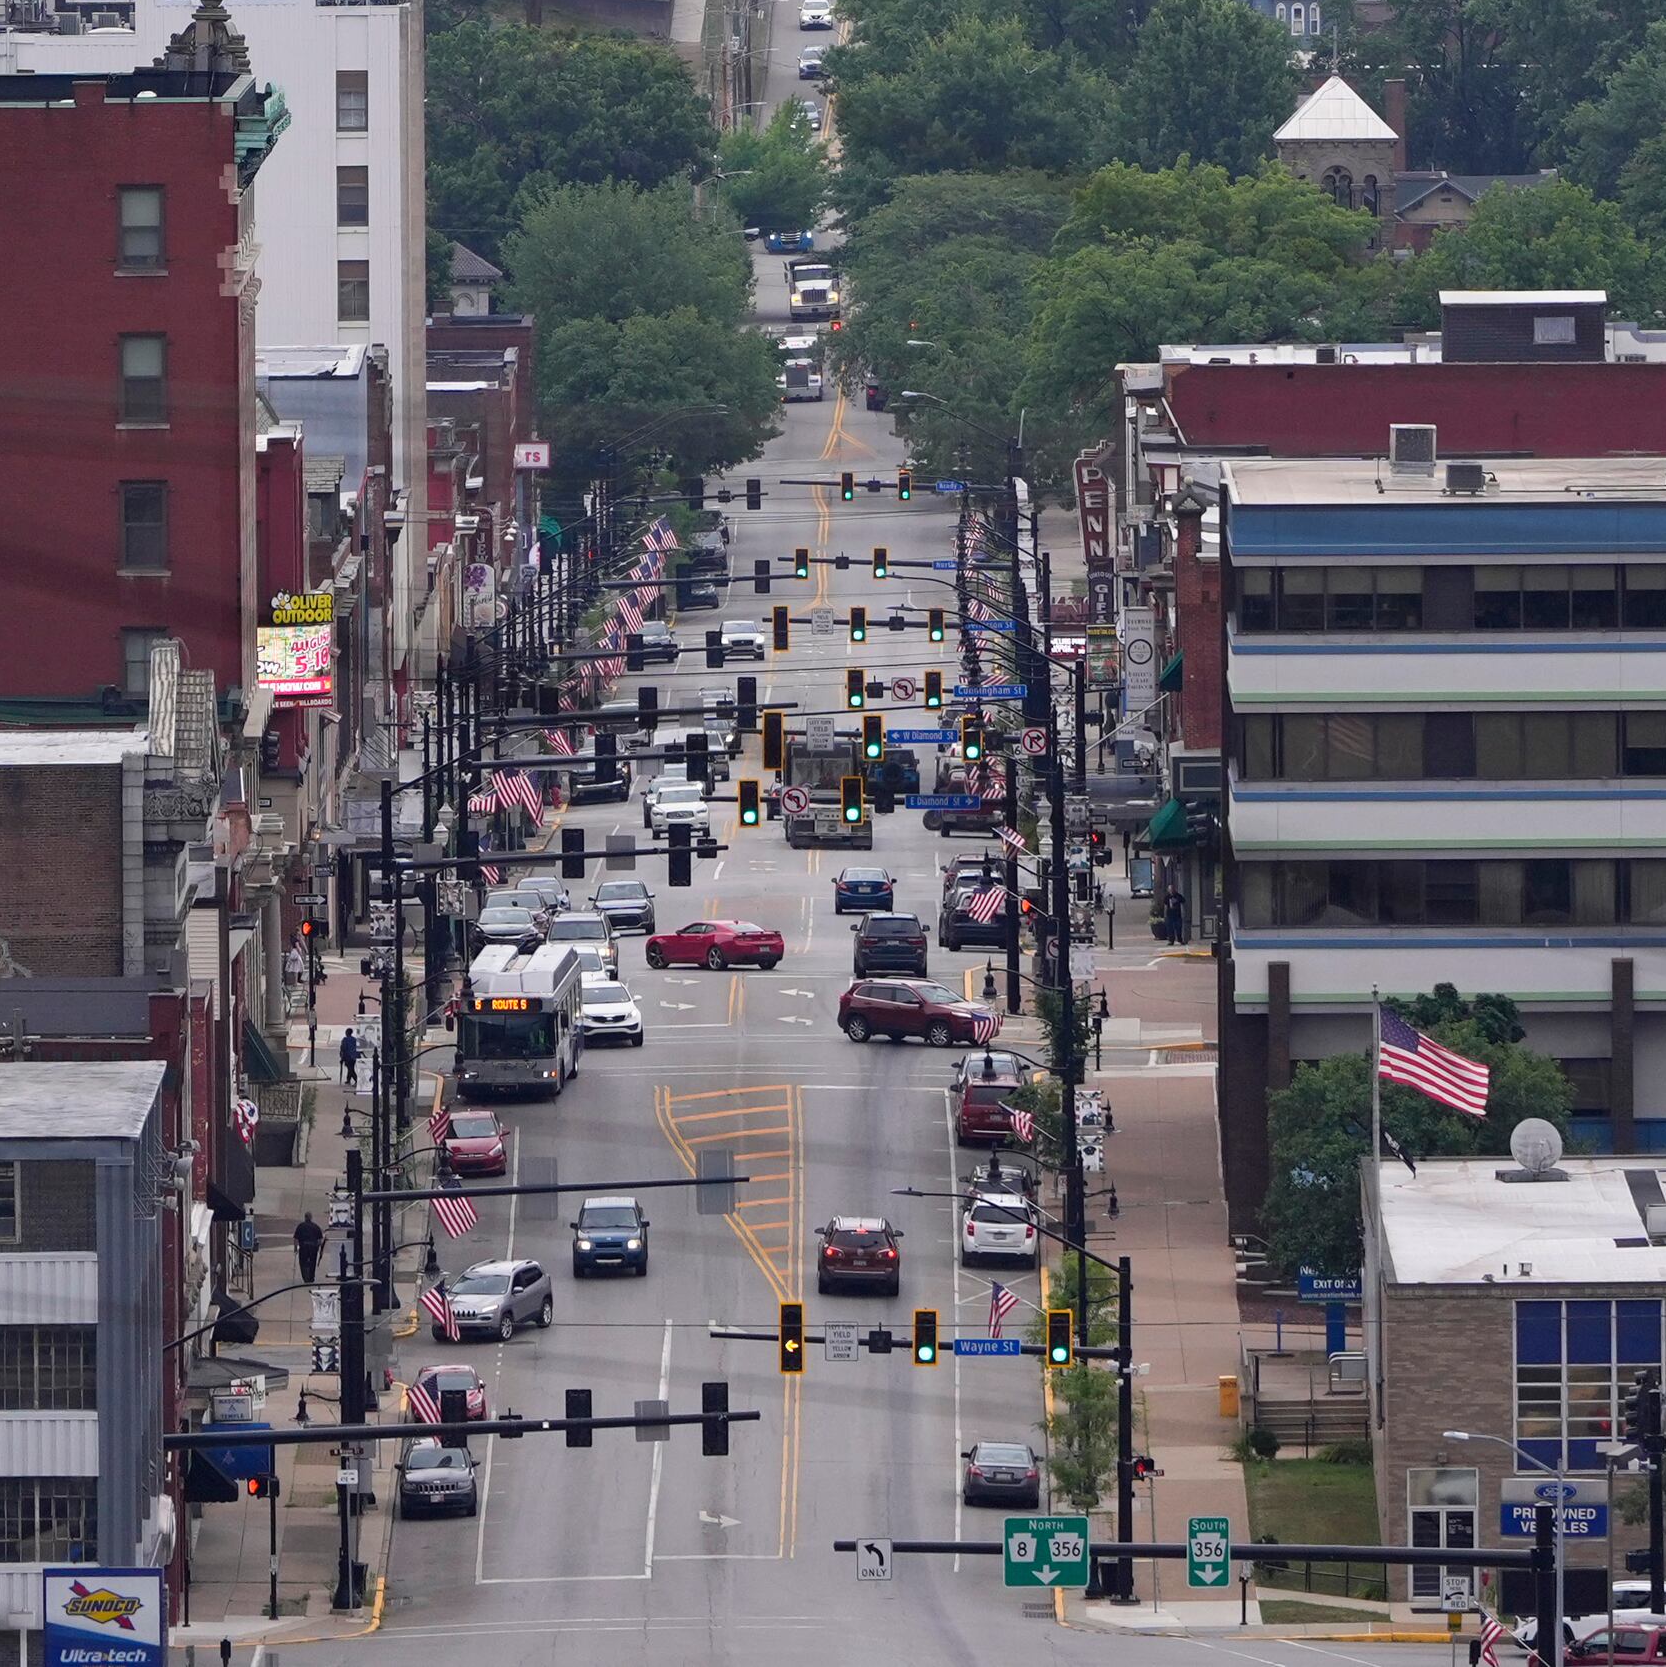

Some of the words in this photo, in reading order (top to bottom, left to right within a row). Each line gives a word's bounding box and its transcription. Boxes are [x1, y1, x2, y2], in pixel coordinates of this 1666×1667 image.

[1081, 466, 1103, 557] PENN
[290, 594, 332, 609] OLIVER
[273, 608, 332, 624] OUTDOOR
[957, 686, 1010, 696] Cunningham
[1013, 686, 1022, 695] St
[903, 732, 911, 740] W
[912, 732, 943, 740] Diamond
[947, 732, 954, 740] St
[910, 797, 914, 805] E
[917, 797, 948, 805] Diamond
[953, 797, 960, 805] St
[492, 1000, 518, 1010] ROUTE
[1313, 1279, 1332, 1289] EXIT
[960, 1340, 998, 1354] Wayne
[1003, 1340, 1014, 1352] St
[1028, 1519, 1064, 1531] NORTH
[1191, 1519, 1227, 1531] SOUTH
[1017, 1541, 1027, 1557] 8
[1052, 1541, 1081, 1557] 356
[1193, 1541, 1223, 1558] 356
[861, 1568, 887, 1577] ONLY
[1445, 1578, 1466, 1586] STOP
[68, 1599, 137, 1613] SUNOCO
[1450, 1600, 1466, 1608] RED
